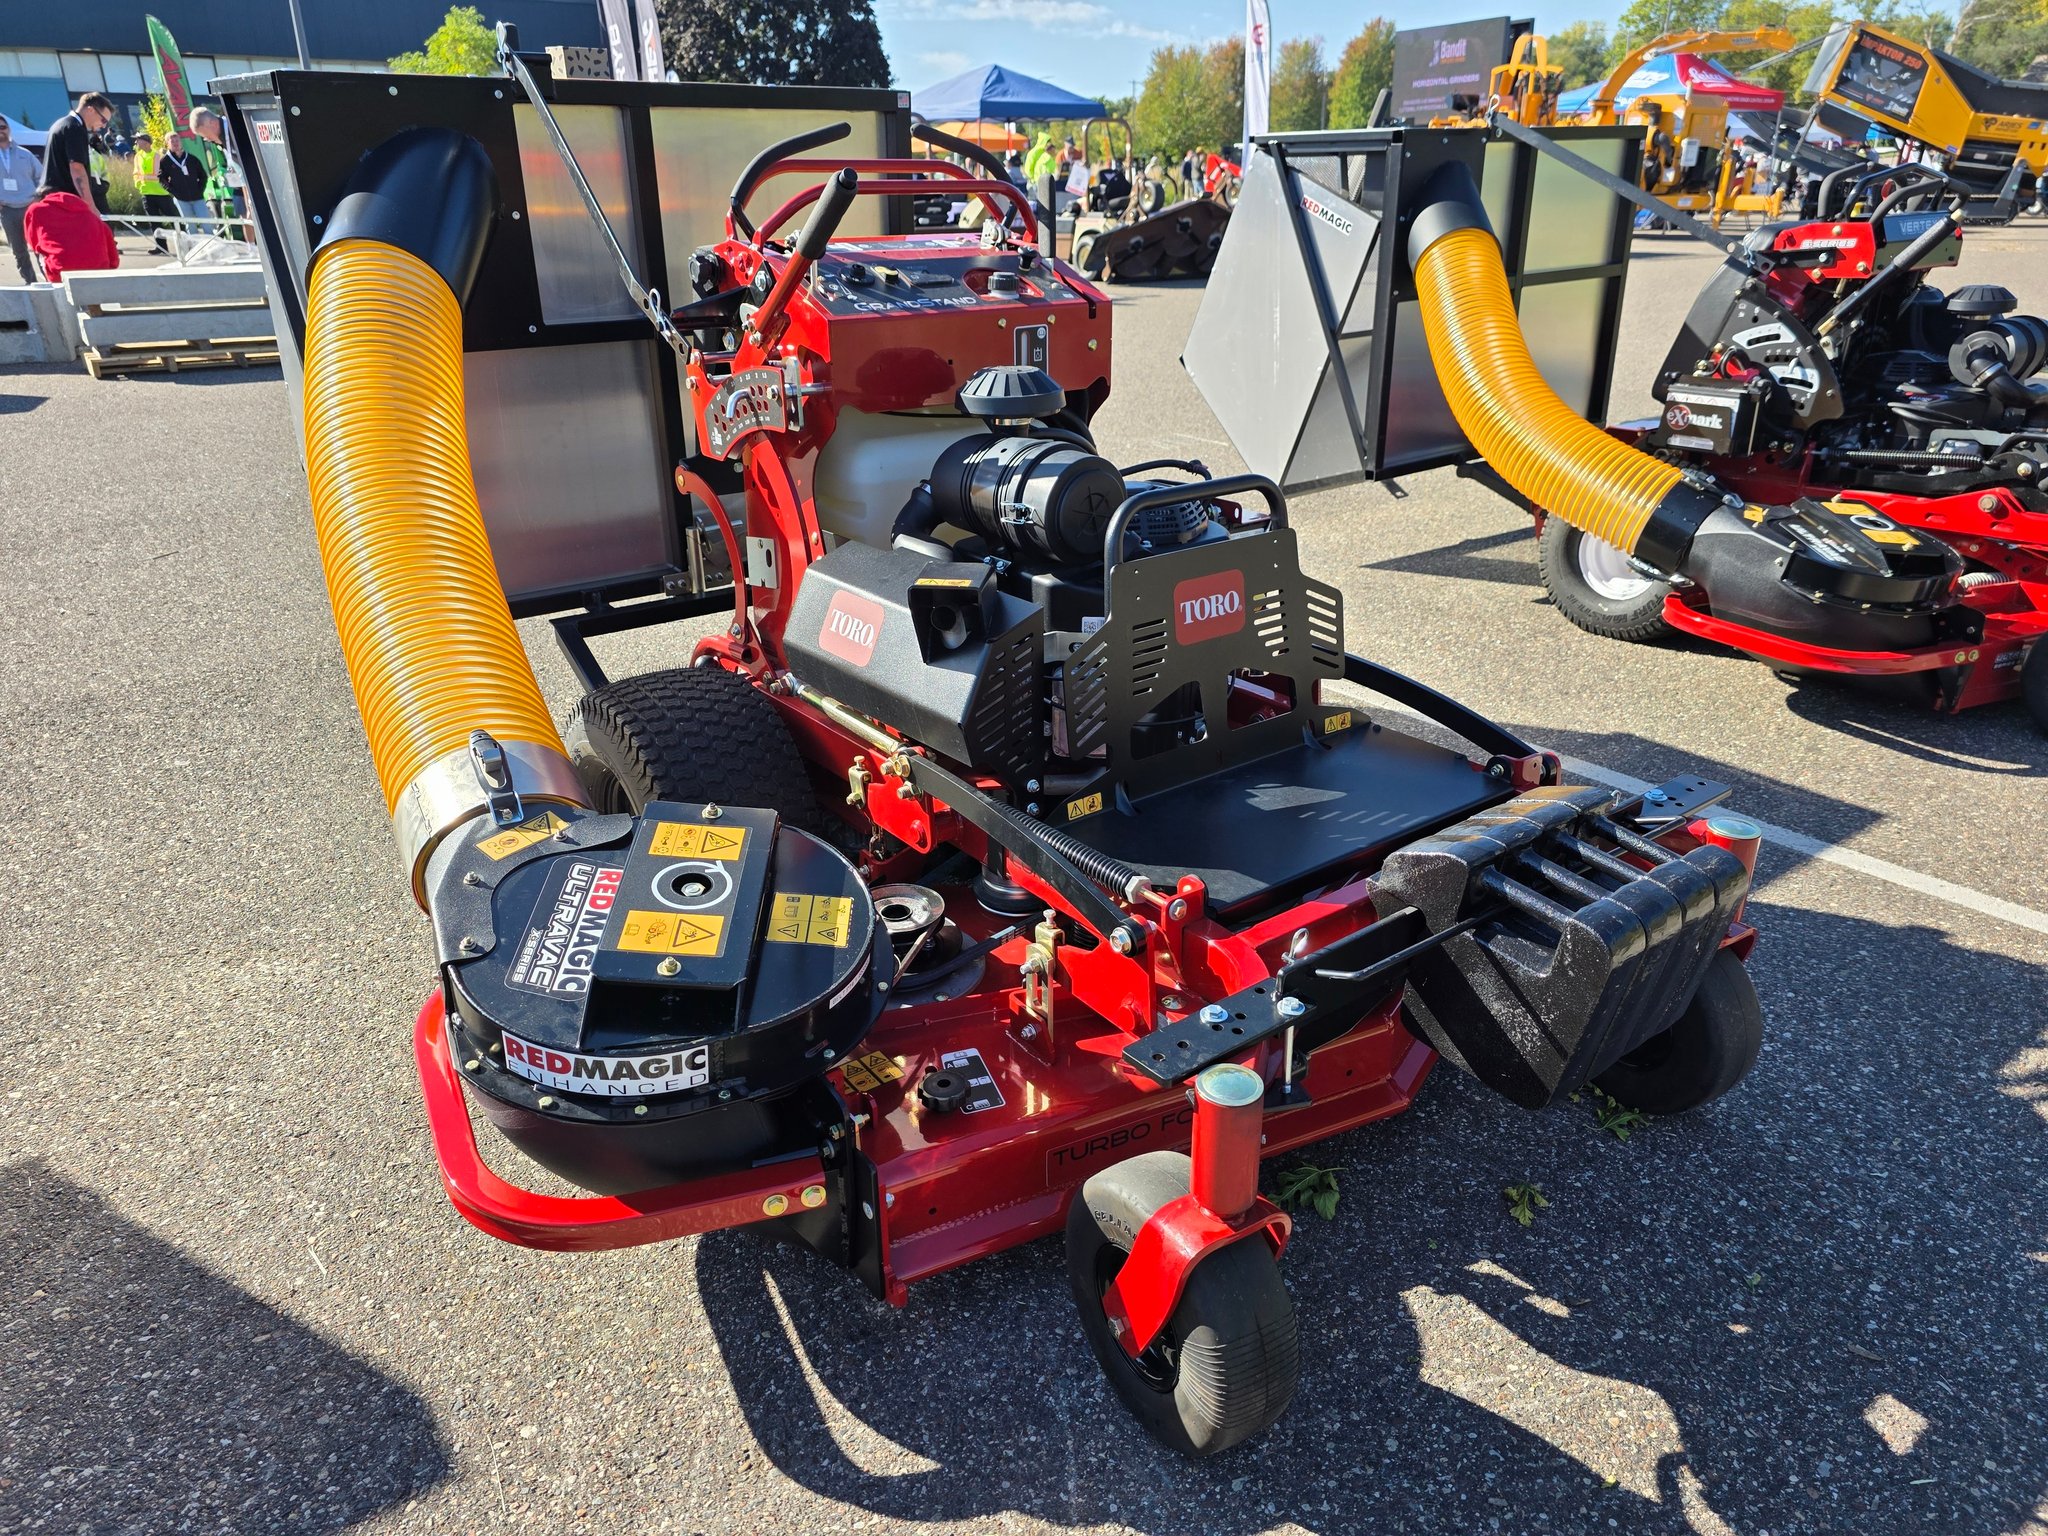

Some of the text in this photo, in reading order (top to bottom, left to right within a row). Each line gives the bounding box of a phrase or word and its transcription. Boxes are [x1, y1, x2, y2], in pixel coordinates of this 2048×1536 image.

[1440, 38, 1467, 58] Bandit
[157, 47, 196, 140] AVANT
[1301, 196, 1352, 234] REDMAGIC
[829, 608, 875, 646] TORO
[1180, 590, 1240, 625] TORO
[527, 863, 596, 990] ULTRAVAC
[557, 870, 624, 991] REDMAGIC
[505, 1036, 706, 1081] REDMAGIC
[508, 1060, 707, 1095] ENHANCED
[1053, 1122, 1151, 1166] TURBO
